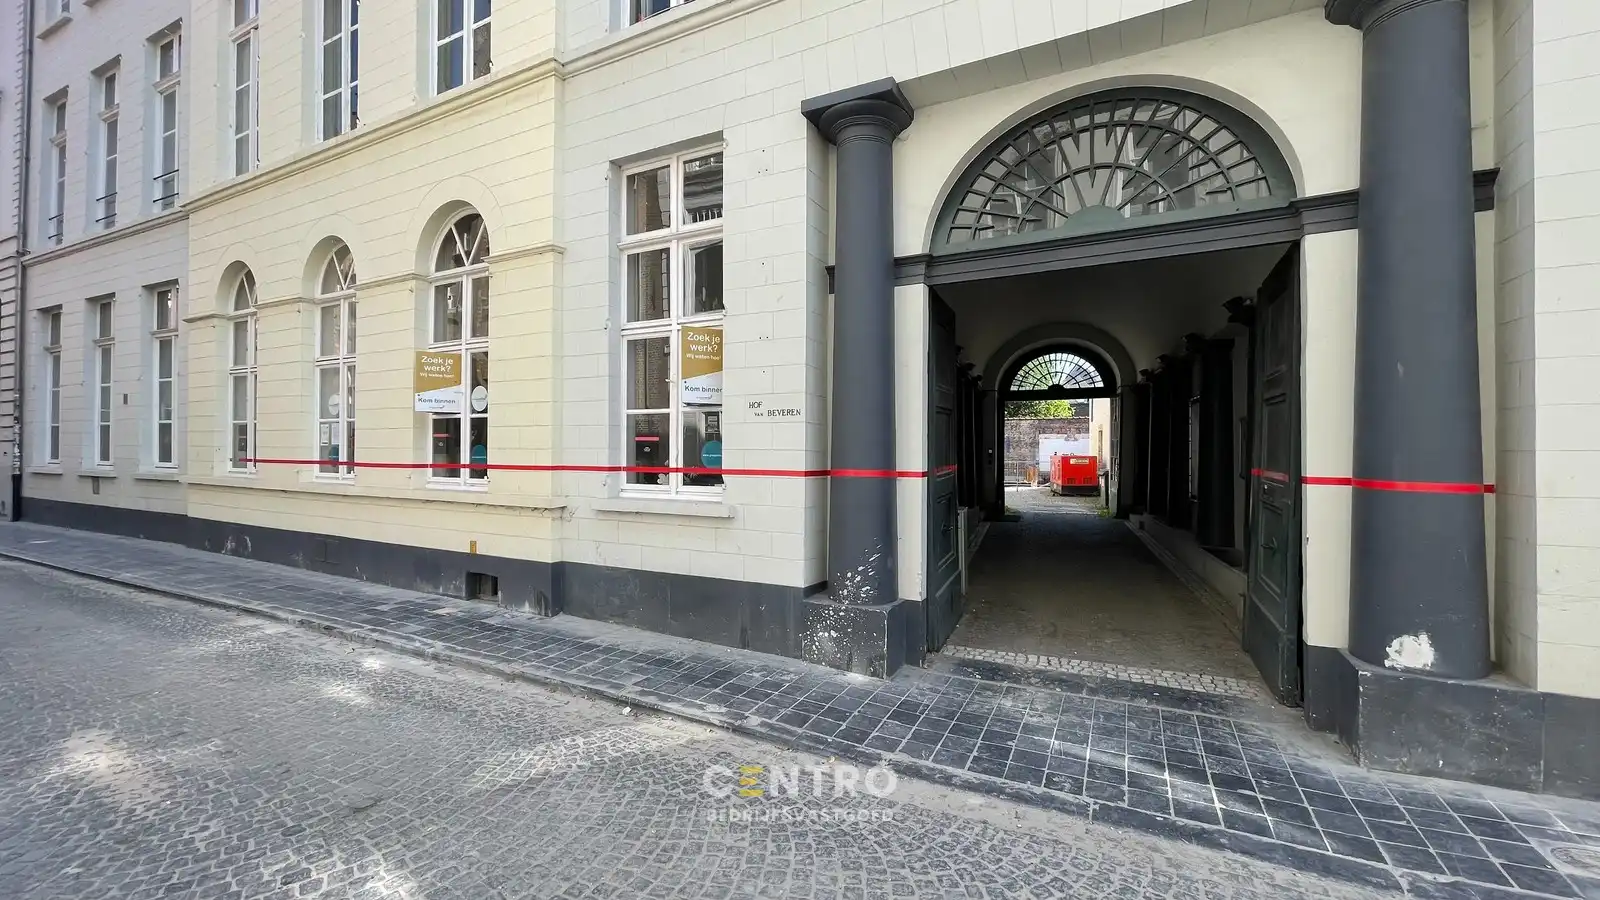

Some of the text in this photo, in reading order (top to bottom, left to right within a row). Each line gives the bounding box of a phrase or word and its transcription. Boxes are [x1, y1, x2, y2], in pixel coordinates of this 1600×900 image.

[687, 332, 720, 344] Zoek je
[690, 344, 718, 353] werk?
[421, 355, 443, 364] Zoek
[685, 384, 700, 392] Kom
[748, 401, 763, 409] HOF
[767, 408, 801, 417] BEVEREN
